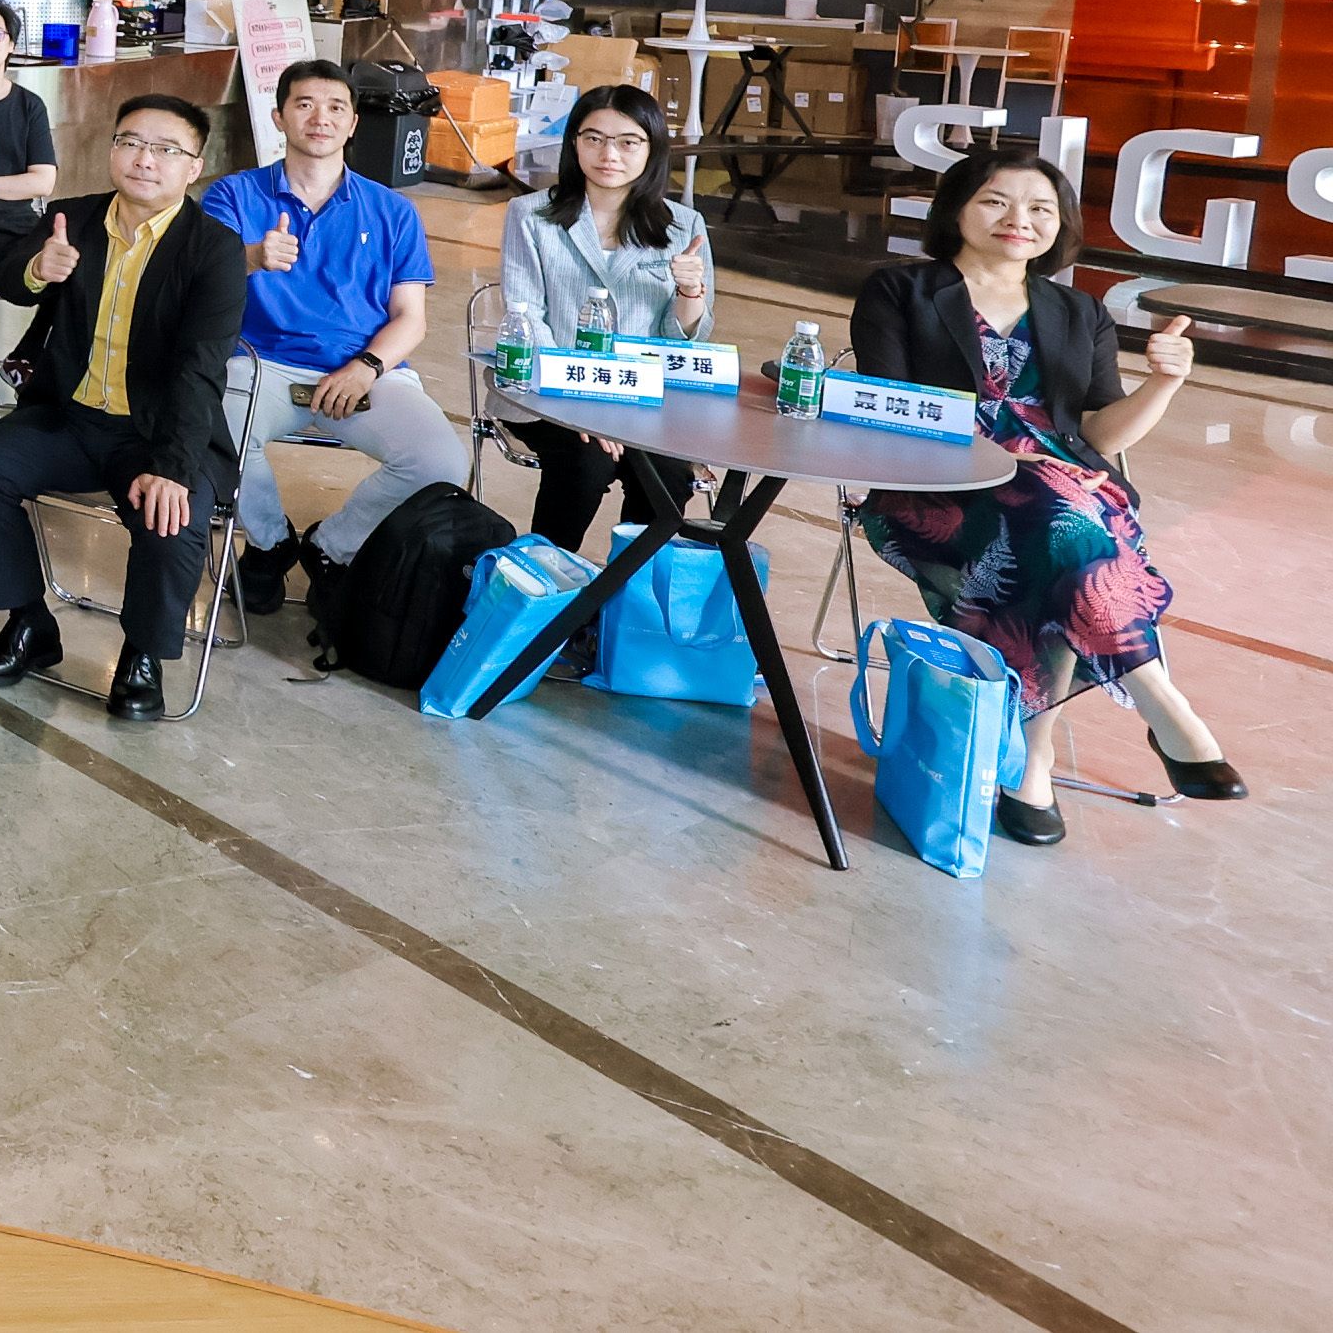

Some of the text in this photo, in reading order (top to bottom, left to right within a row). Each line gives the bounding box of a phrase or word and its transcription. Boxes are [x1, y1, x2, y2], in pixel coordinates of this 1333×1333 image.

[565, 364, 639, 388] 郑海涛
[642, 353, 715, 376] 梦瑶
[853, 388, 945, 422] 聂晓梅
